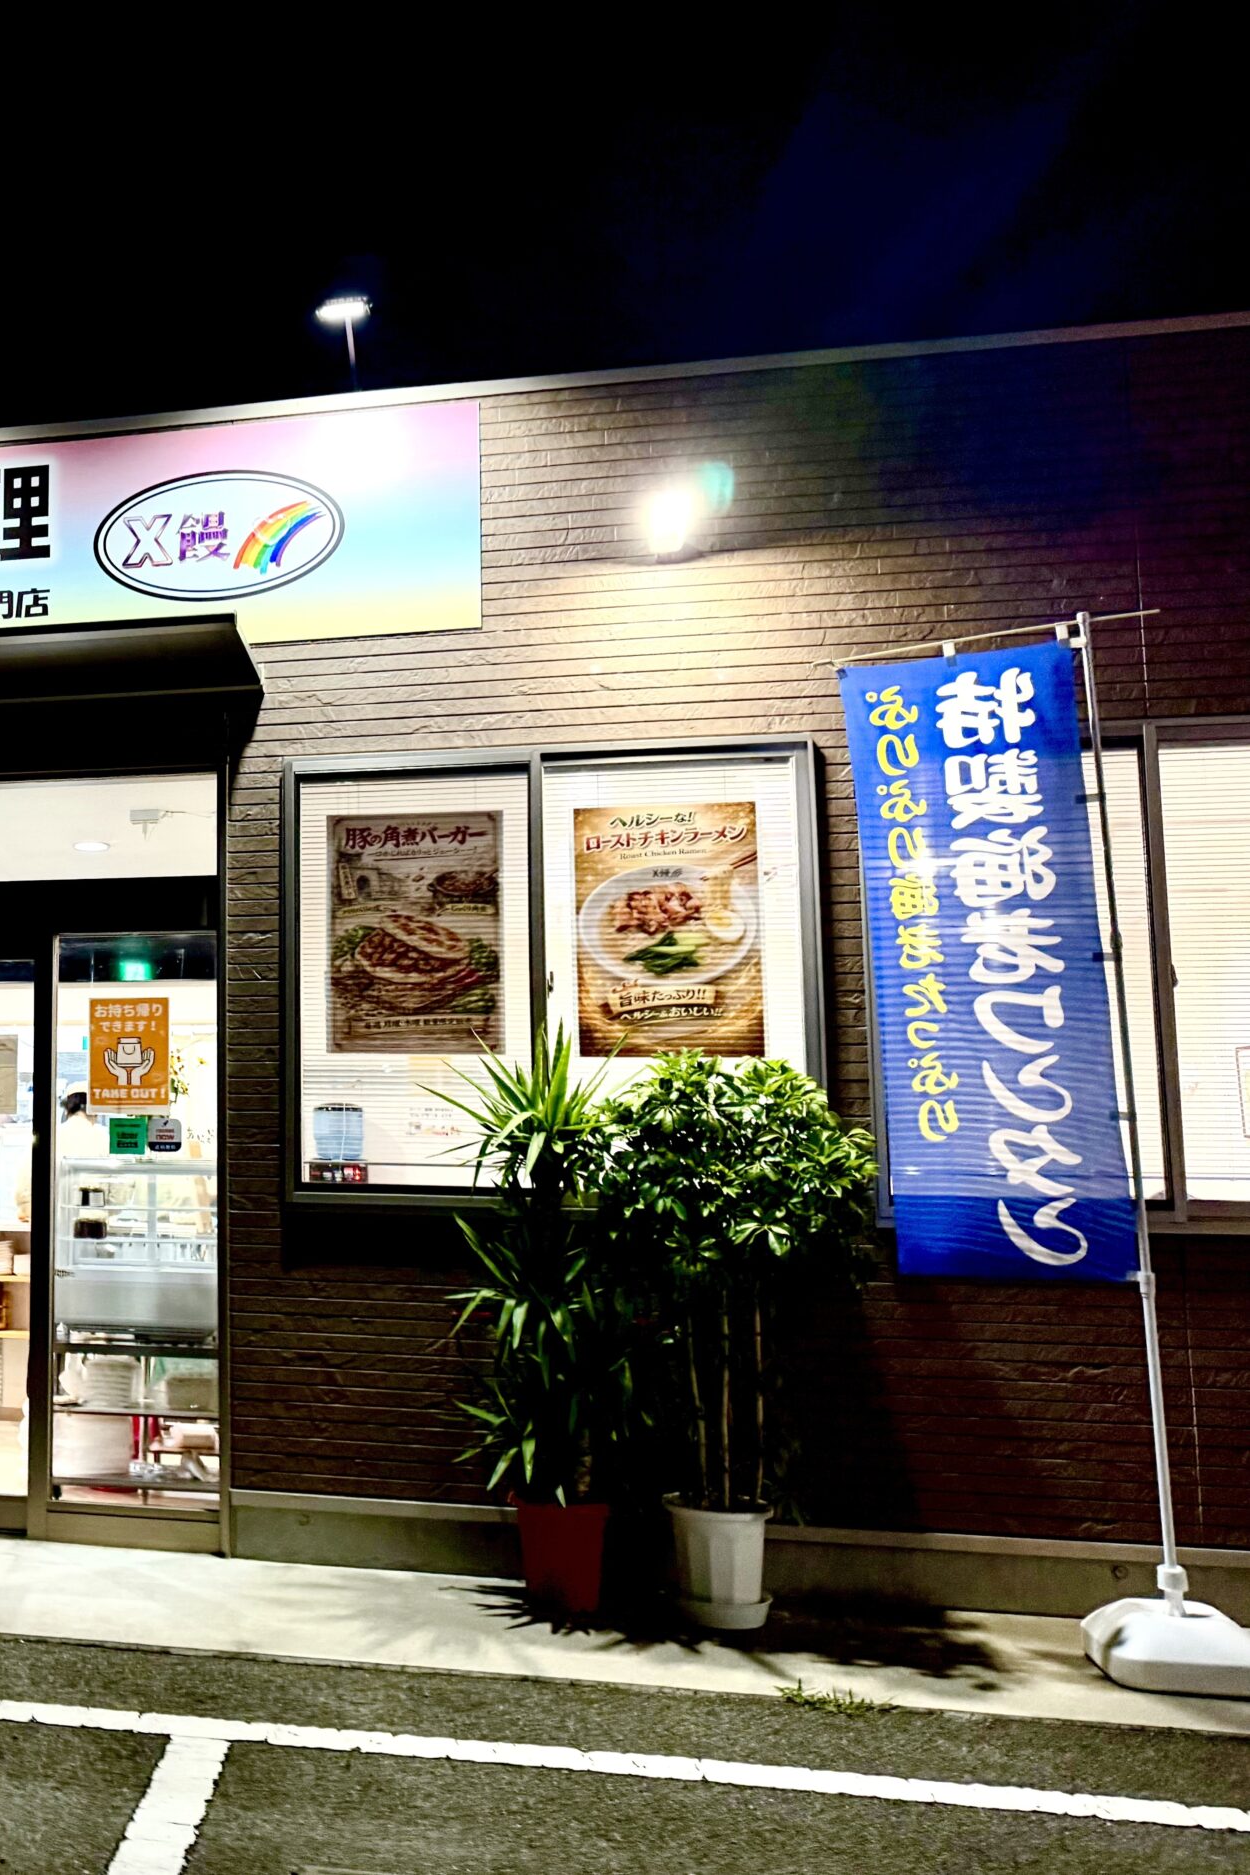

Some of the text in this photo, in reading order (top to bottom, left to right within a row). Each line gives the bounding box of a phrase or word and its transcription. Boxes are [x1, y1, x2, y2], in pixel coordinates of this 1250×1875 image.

[344, 824, 488, 850] 豚の角煮バーガー
[586, 825, 747, 851] ローストチキンラーメン
[620, 847, 707, 860] Roast Chicken Ramen
[94, 1003, 164, 1018] お持ち帰り
